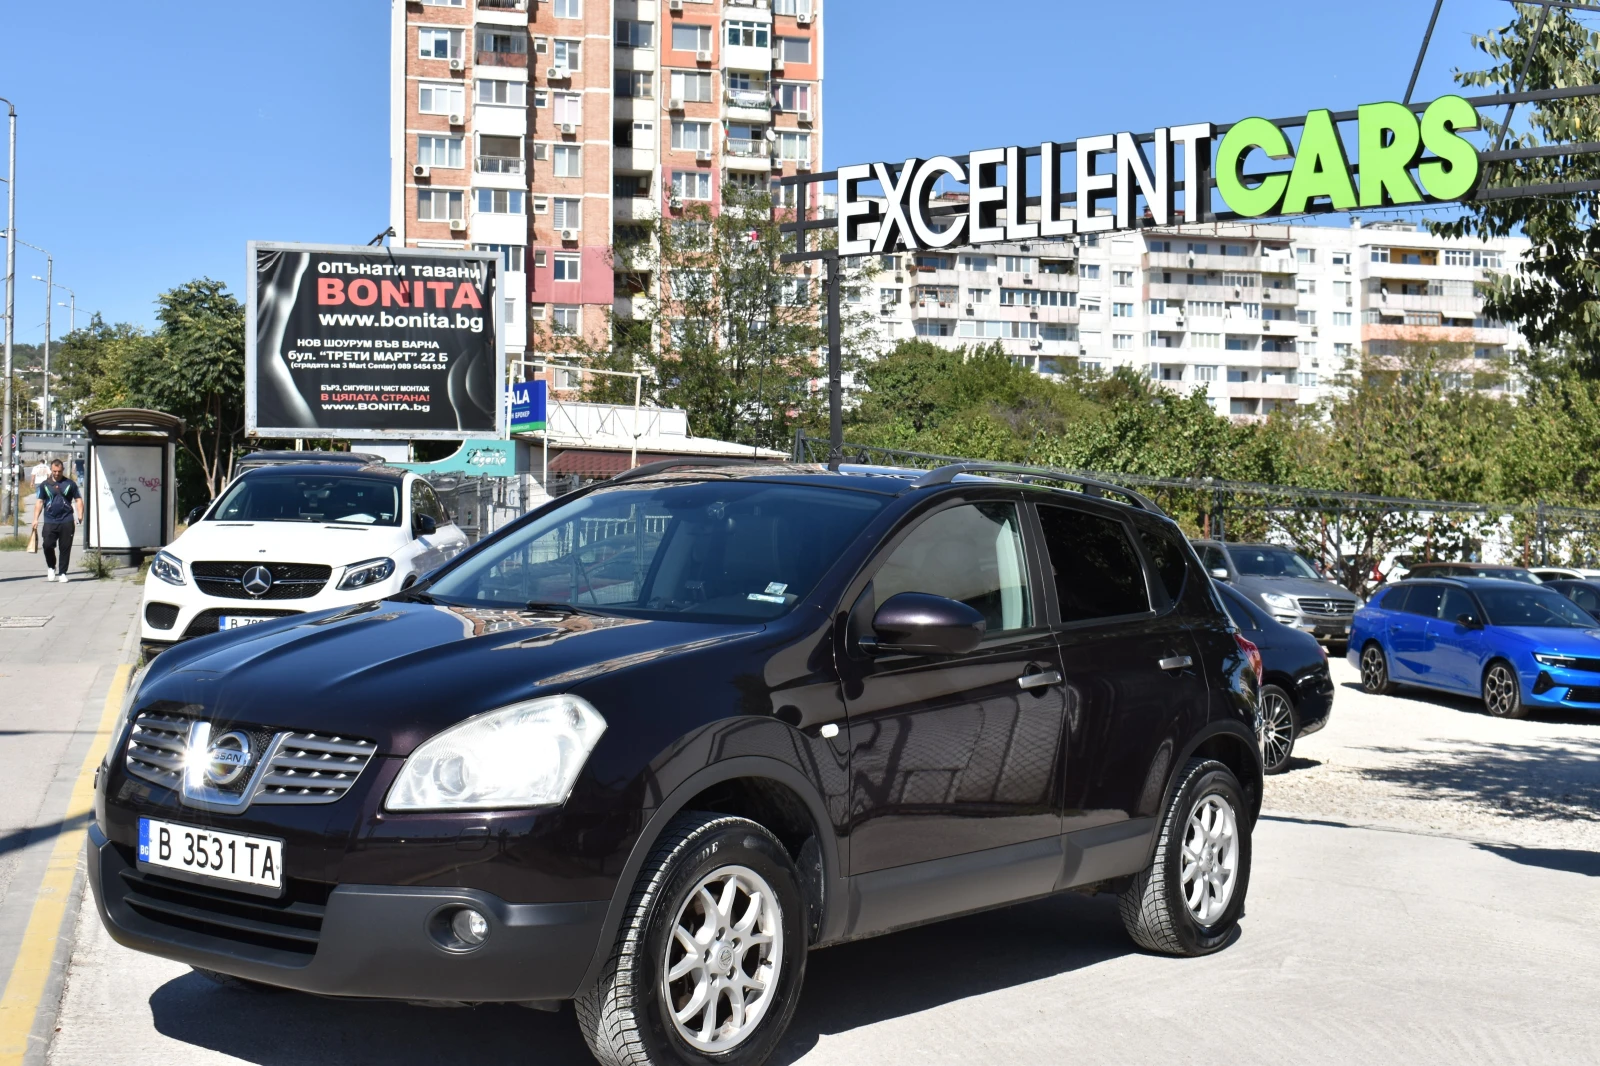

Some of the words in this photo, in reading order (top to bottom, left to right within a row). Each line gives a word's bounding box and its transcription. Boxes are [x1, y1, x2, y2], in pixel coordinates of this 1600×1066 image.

[837, 122, 1215, 256] EXCELLENT
[1214, 94, 1481, 218] CARS
[317, 261, 406, 277] опънати
[411, 265, 481, 279] тавани
[317, 277, 483, 309] BONITA
[318, 311, 484, 333] www.bonita.bg
[296, 338, 322, 348] НОВ
[323, 339, 373, 349] ШОУРУМ
[375, 340, 399, 349] ВЪВ
[402, 340, 440, 350] ВАРНА
[288, 350, 316, 362] бул.
[421, 353, 436, 362] 22
[439, 353, 449, 362] Б
[291, 362, 329, 370] (сградата
[367, 363, 396, 371] Center)
[320, 393, 329, 401] В
[332, 393, 379, 402] ЦЯЛАТА
[381, 394, 430, 402] СТРАНА!
[321, 403, 431, 412] www.BONITA.bg
[140, 844, 149, 856] BG
[159, 827, 171, 861] B
[183, 832, 236, 874] 3531
[244, 842, 275, 880] TA
